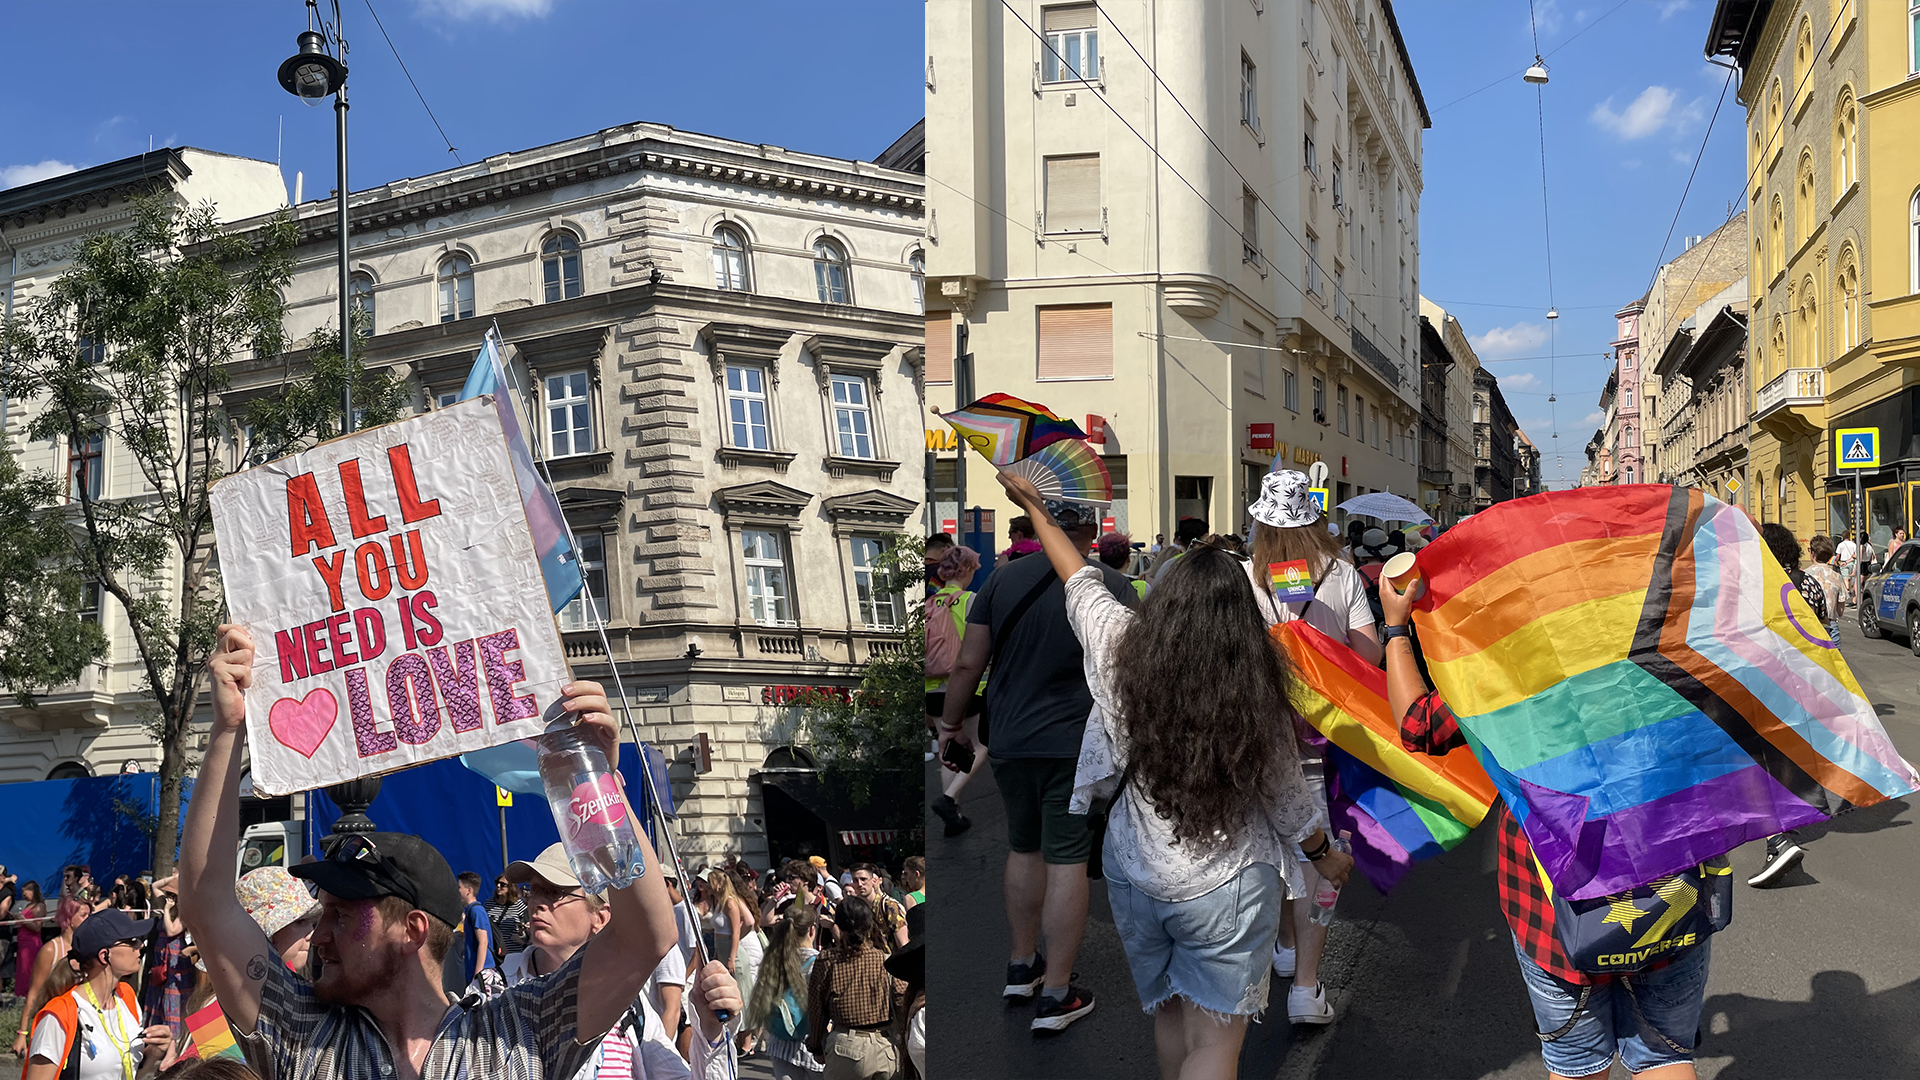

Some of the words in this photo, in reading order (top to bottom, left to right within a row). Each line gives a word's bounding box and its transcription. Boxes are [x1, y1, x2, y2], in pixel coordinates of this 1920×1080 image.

[286, 443, 442, 558] ALL
[312, 529, 429, 612] YOU
[274, 607, 386, 683] NEED
[398, 591, 443, 651] IS
[344, 628, 539, 758] LOVE
[1597, 933, 1696, 966] CONVERSE
